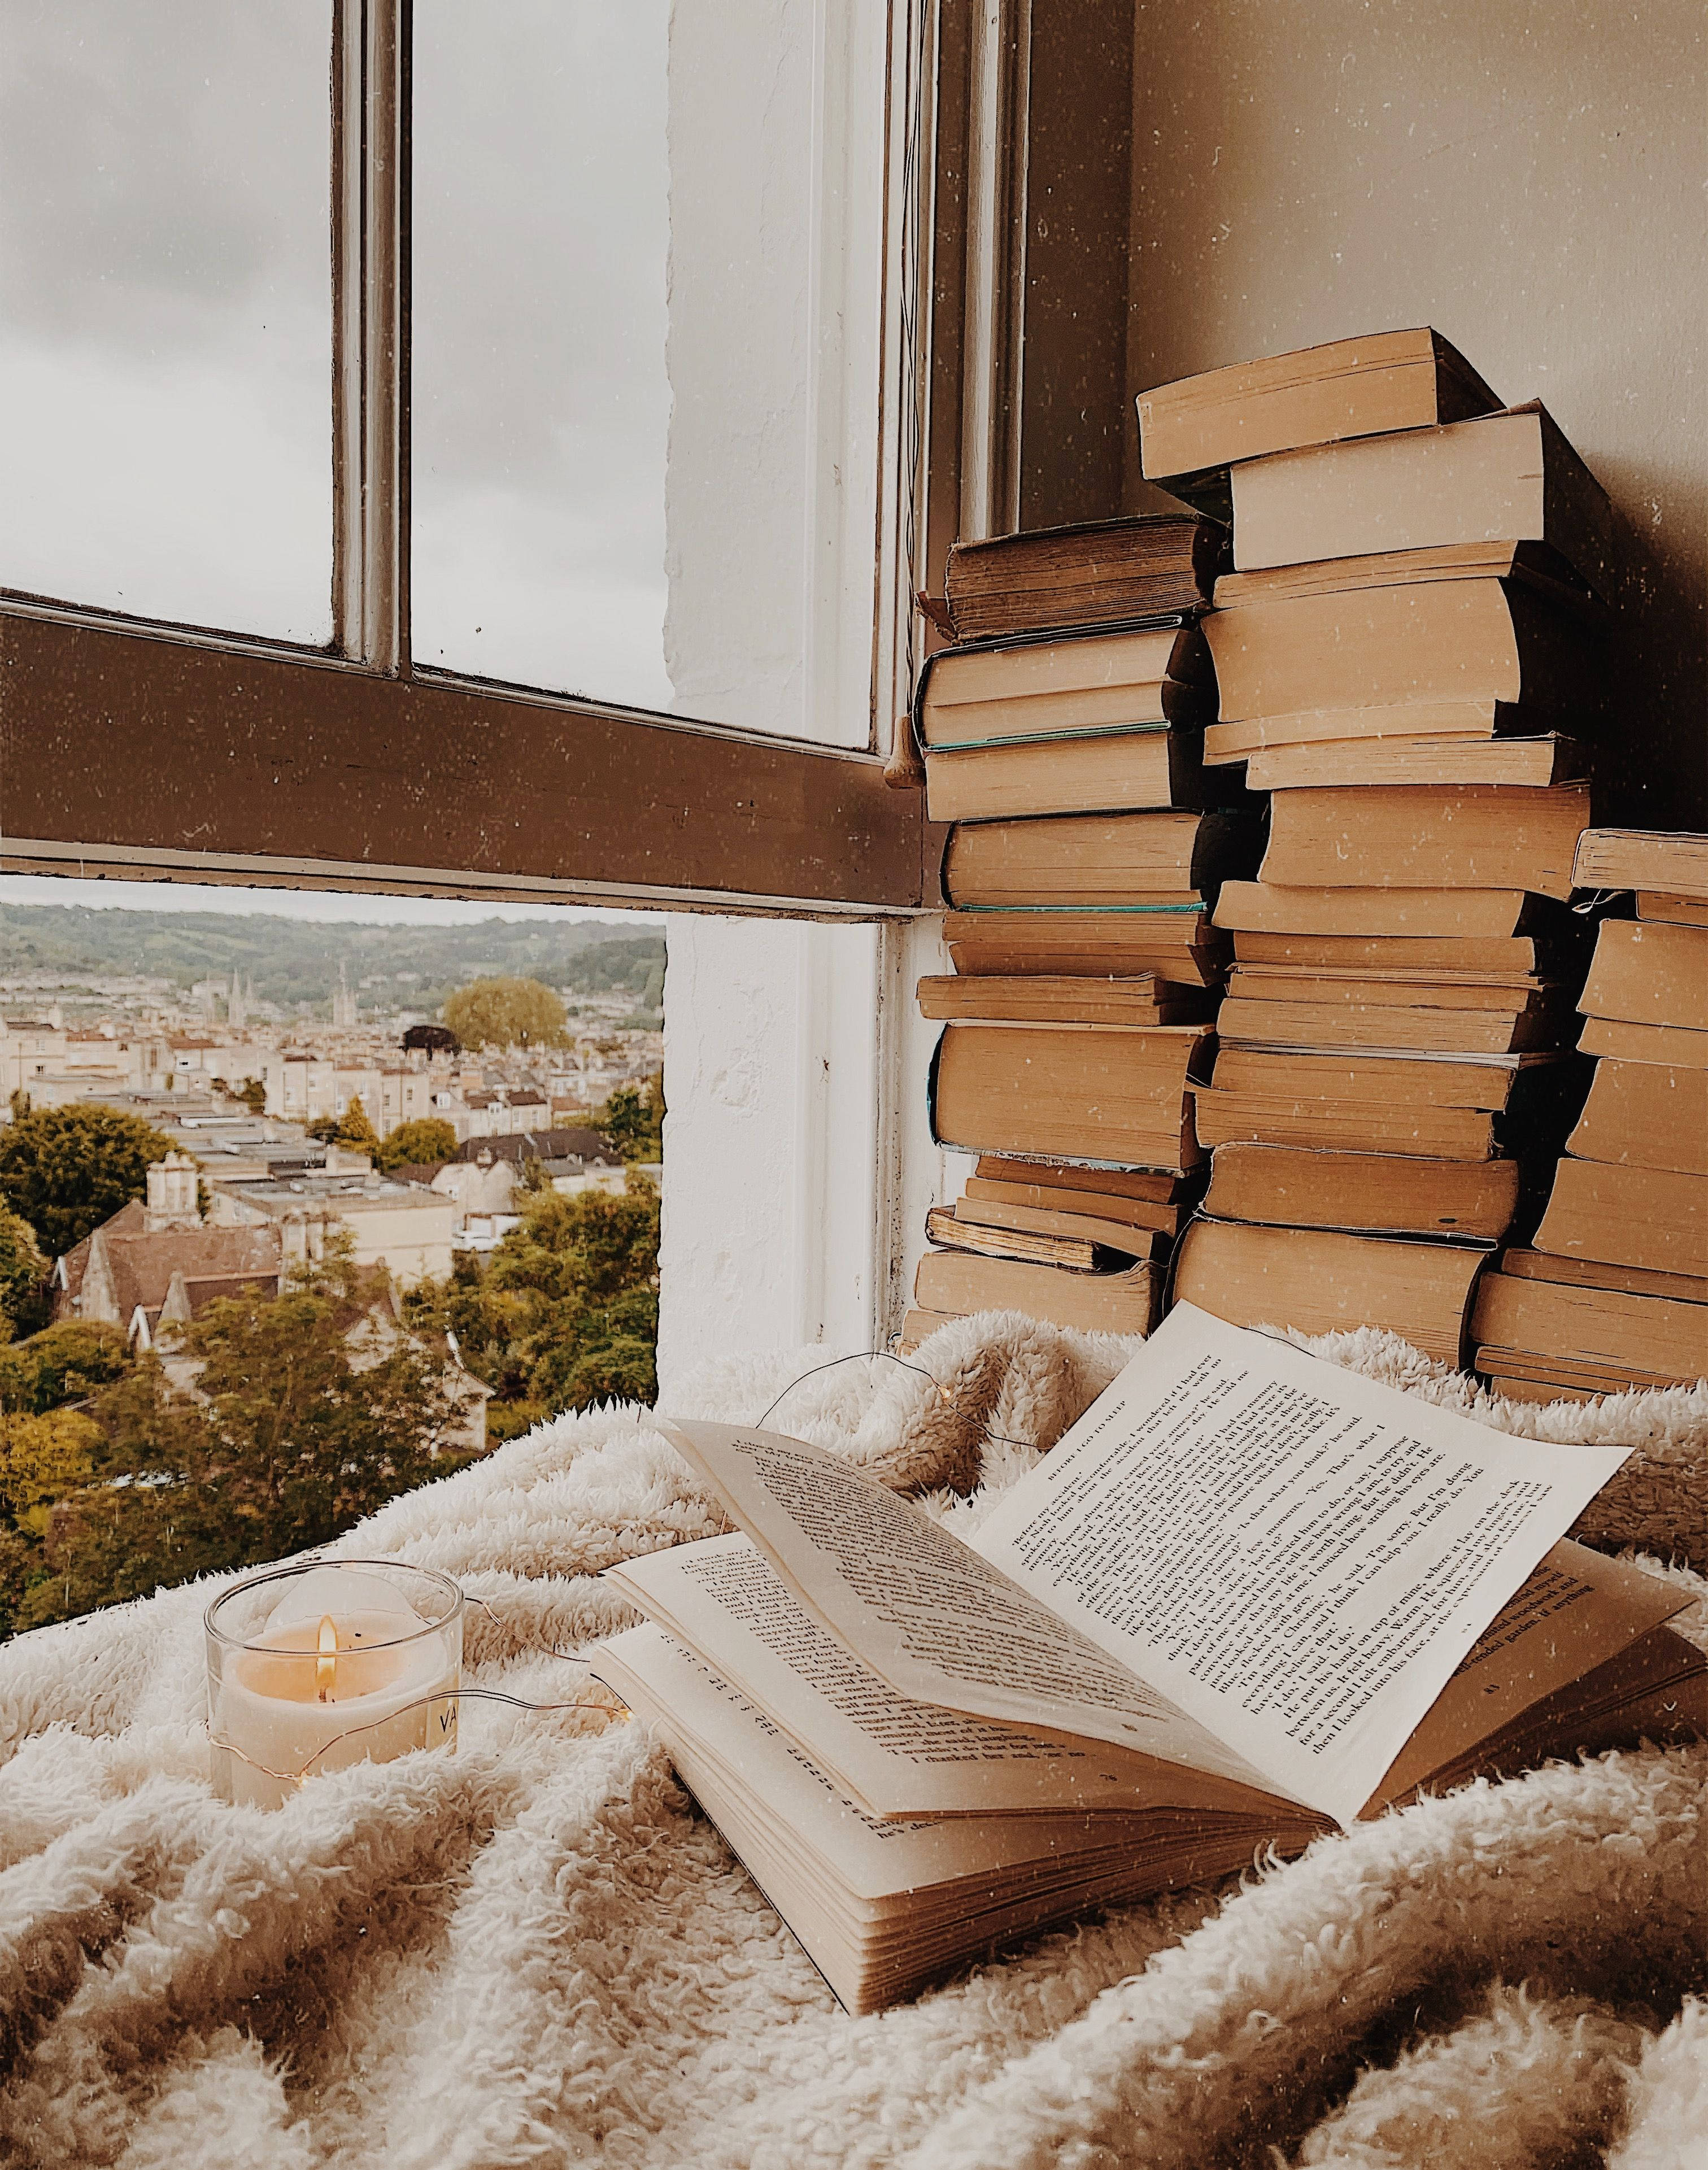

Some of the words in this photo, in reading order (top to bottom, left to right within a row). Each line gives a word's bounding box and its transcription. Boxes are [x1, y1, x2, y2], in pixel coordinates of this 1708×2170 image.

[1019, 1540, 1031, 1553] Dr
[1029, 1518, 1052, 1539] Nash
[1049, 1491, 1078, 1517] looked
[1077, 1439, 1131, 1491] uncomfortable.
[1135, 1397, 1171, 1432] wondered
[1170, 1389, 1178, 1398] if
[1180, 1370, 1198, 1385] had
[1196, 1353, 1212, 1370] ever
[1021, 1537, 1047, 1567] spoken
[1047, 1524, 1057, 1534] to
[1056, 1506, 1074, 1522] him
[1077, 1482, 1099, 1504] about
[1099, 1467, 1113, 1480] the
[1116, 1436, 1145, 1466] accident
[1146, 1419, 1163, 1434] that
[1162, 1404, 1178, 1417] left
[1178, 1390, 1191, 1402] me
[1192, 1371, 1210, 1387] with
[1210, 1358, 1222, 1369] no
[1048, 1453, 1076, 1481] BEFORE
[1082, 1436, 1093, 1447] GO
[1094, 1423, 1105, 1433] TO
[1105, 1401, 1126, 1421] SLEEP
[1077, 1590, 1087, 1603] of
[1086, 1578, 1100, 1592] the
[1100, 1542, 1135, 1578] accident,
[1134, 1523, 1149, 1541] and
[1148, 1513, 1159, 1523] so
[1187, 1461, 1208, 1480] seem
[1206, 1445, 1226, 1461] real.
[1224, 1431, 1239, 1444] All
[1240, 1411, 1259, 1426] had
[1257, 1393, 1277, 1411] were
[1276, 1384, 1288, 1394] its
[1102, 1595, 1124, 1619] never
[1122, 1574, 1144, 1594] been
[1143, 1542, 1174, 1572] caught,
[1171, 1518, 1193, 1540] never
[1191, 1498, 1214, 1517] been
[1213, 1462, 1249, 1498] punished
[1246, 1450, 1262, 1463] for
[1258, 1424, 1292, 1450] leaving
[1289, 1411, 1304, 1424] me
[1300, 1397, 1319, 1411] like
[1110, 1606, 1130, 1625] this.
[1126, 1589, 1143, 1605] For
[1143, 1557, 1173, 1588] ruining
[1170, 1544, 1184, 1557] my
[1181, 1527, 1201, 1542] life.
[1197, 1510, 1215, 1526] But
[1213, 1497, 1228, 1511] the
[1227, 1480, 1245, 1497] odd
[1243, 1461, 1267, 1481] thing
[1300, 1407, 1325, 1428] really.
[1210, 1600, 1237, 1626] know
[1236, 1576, 1260, 1598] what
[1264, 1534, 1302, 1571] expected
[1297, 1519, 1320, 1536] him
[1317, 1509, 1330, 1519] to
[1327, 1497, 1346, 1509] do,
[1343, 1485, 1356, 1496] or
[1353, 1471, 1372, 1485] say.
[1375, 1435, 1409, 1465] suppose
[1028, 1537, 1060, 1572] memory.
[1199, 1640, 1235, 1682] convince
[1234, 1623, 1249, 1639] me
[1248, 1602, 1268, 1622] that
[1267, 1587, 1283, 1602] my
[1280, 1572, 1299, 1587] life
[1298, 1563, 1309, 1572] is
[1308, 1538, 1336, 1562] worth
[1332, 1514, 1363, 1537] living.
[1360, 1496, 1380, 1512] But
[1375, 1485, 1392, 1497] he
[1415, 1446, 1433, 1459] He
[1509, 1590, 1559, 1620] woodwork
[1559, 1577, 1579, 1591] and
[1533, 1571, 1565, 1591] myself
[1552, 1585, 1595, 1610] anything
[756, 1628, 791, 1636] stayed
[1217, 1671, 1244, 1694] Blue,
[1240, 1633, 1273, 1668] flecked
[1270, 1614, 1293, 1633] with
[1292, 1594, 1315, 1615] grey.
[1284, 1698, 1327, 1738] between
[1324, 1685, 1341, 1698] us.
[1336, 1674, 1350, 1684] It
[1345, 1659, 1366, 1675] felt
[1360, 1633, 1395, 1660] heavy.
[1389, 1604, 1424, 1630] Warm.
[1418, 1588, 1438, 1602] He
[1436, 1548, 1475, 1588] squeezed
[1472, 1532, 1488, 1548] my
[1484, 1500, 1518, 1532] fingers,
[1515, 1481, 1532, 1498] and
[822, 1679, 856, 1687] could
[852, 1714, 913, 1724] suggested
[925, 1753, 978, 1763] thanked
